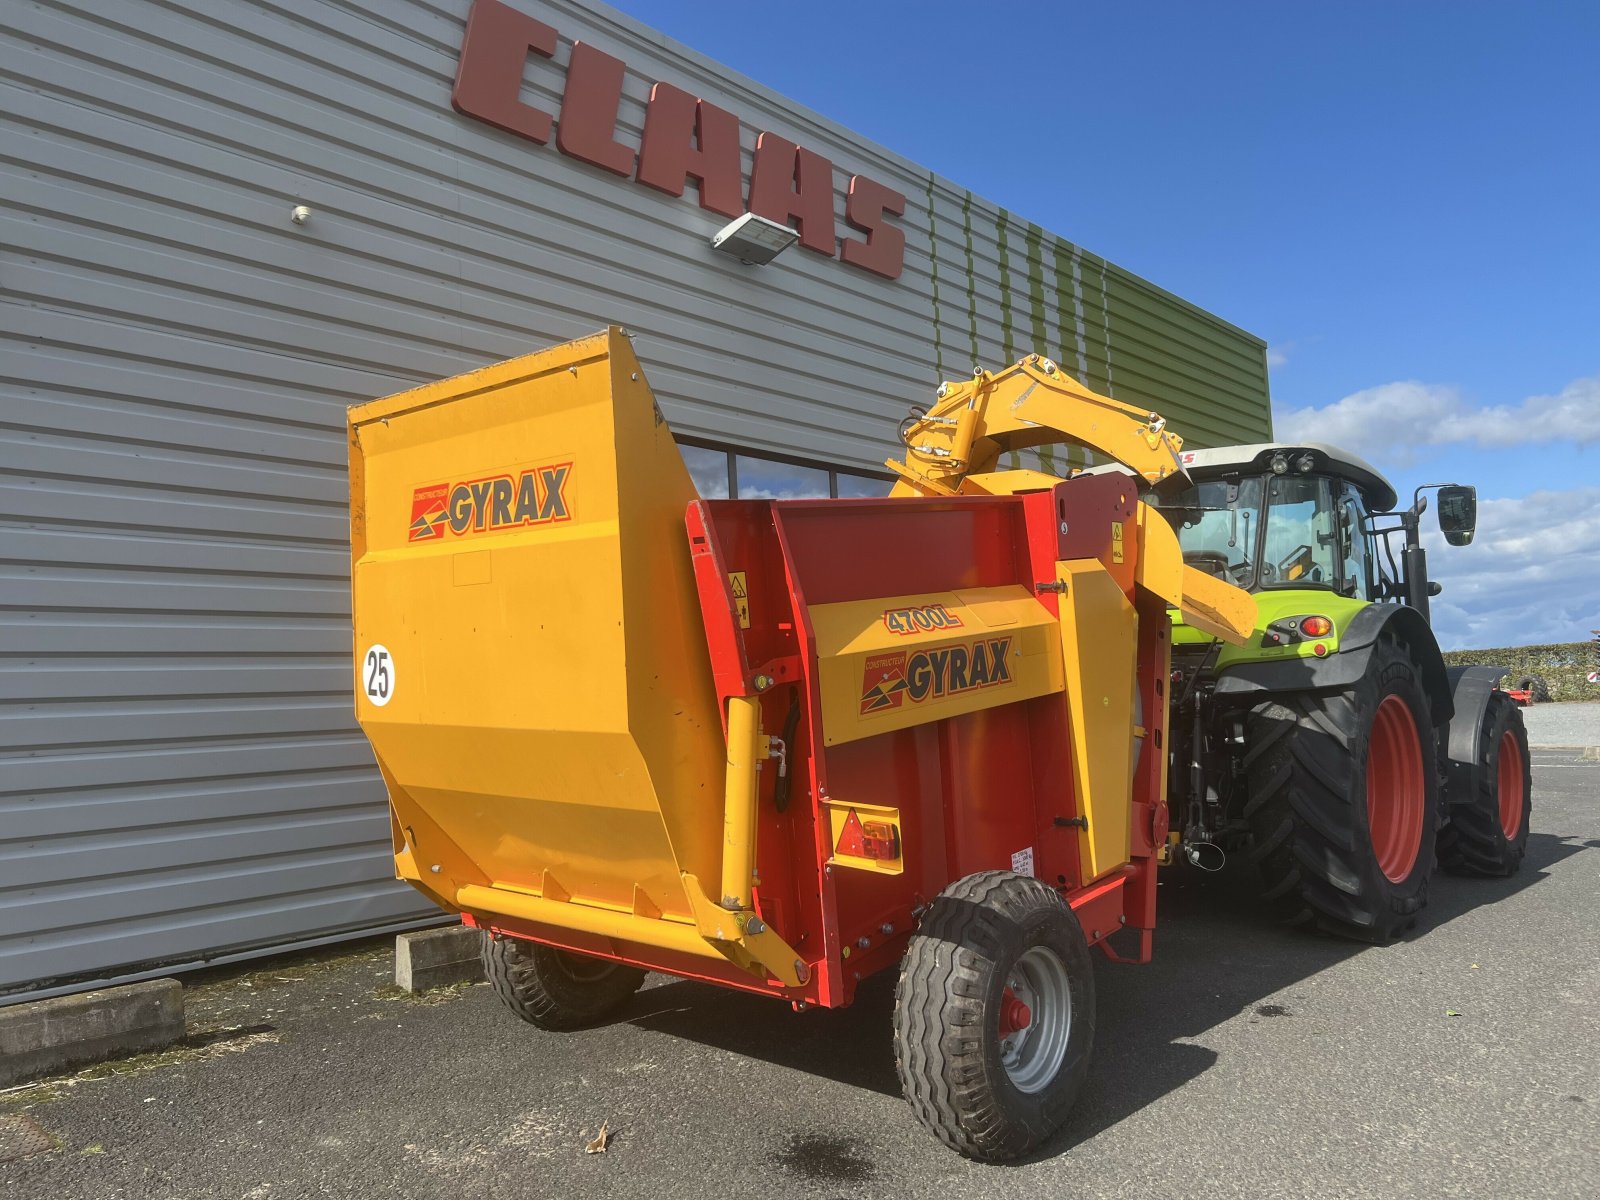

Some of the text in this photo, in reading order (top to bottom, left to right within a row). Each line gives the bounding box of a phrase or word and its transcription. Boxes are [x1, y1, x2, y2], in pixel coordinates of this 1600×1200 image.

[450, 0, 905, 280] CLAAS
[449, 464, 571, 534] GYRAX
[886, 604, 961, 633] 4700L
[367, 651, 389, 698] 25
[865, 656, 905, 670] CONSTRUCTEUR
[906, 638, 1010, 701] GYRAX
